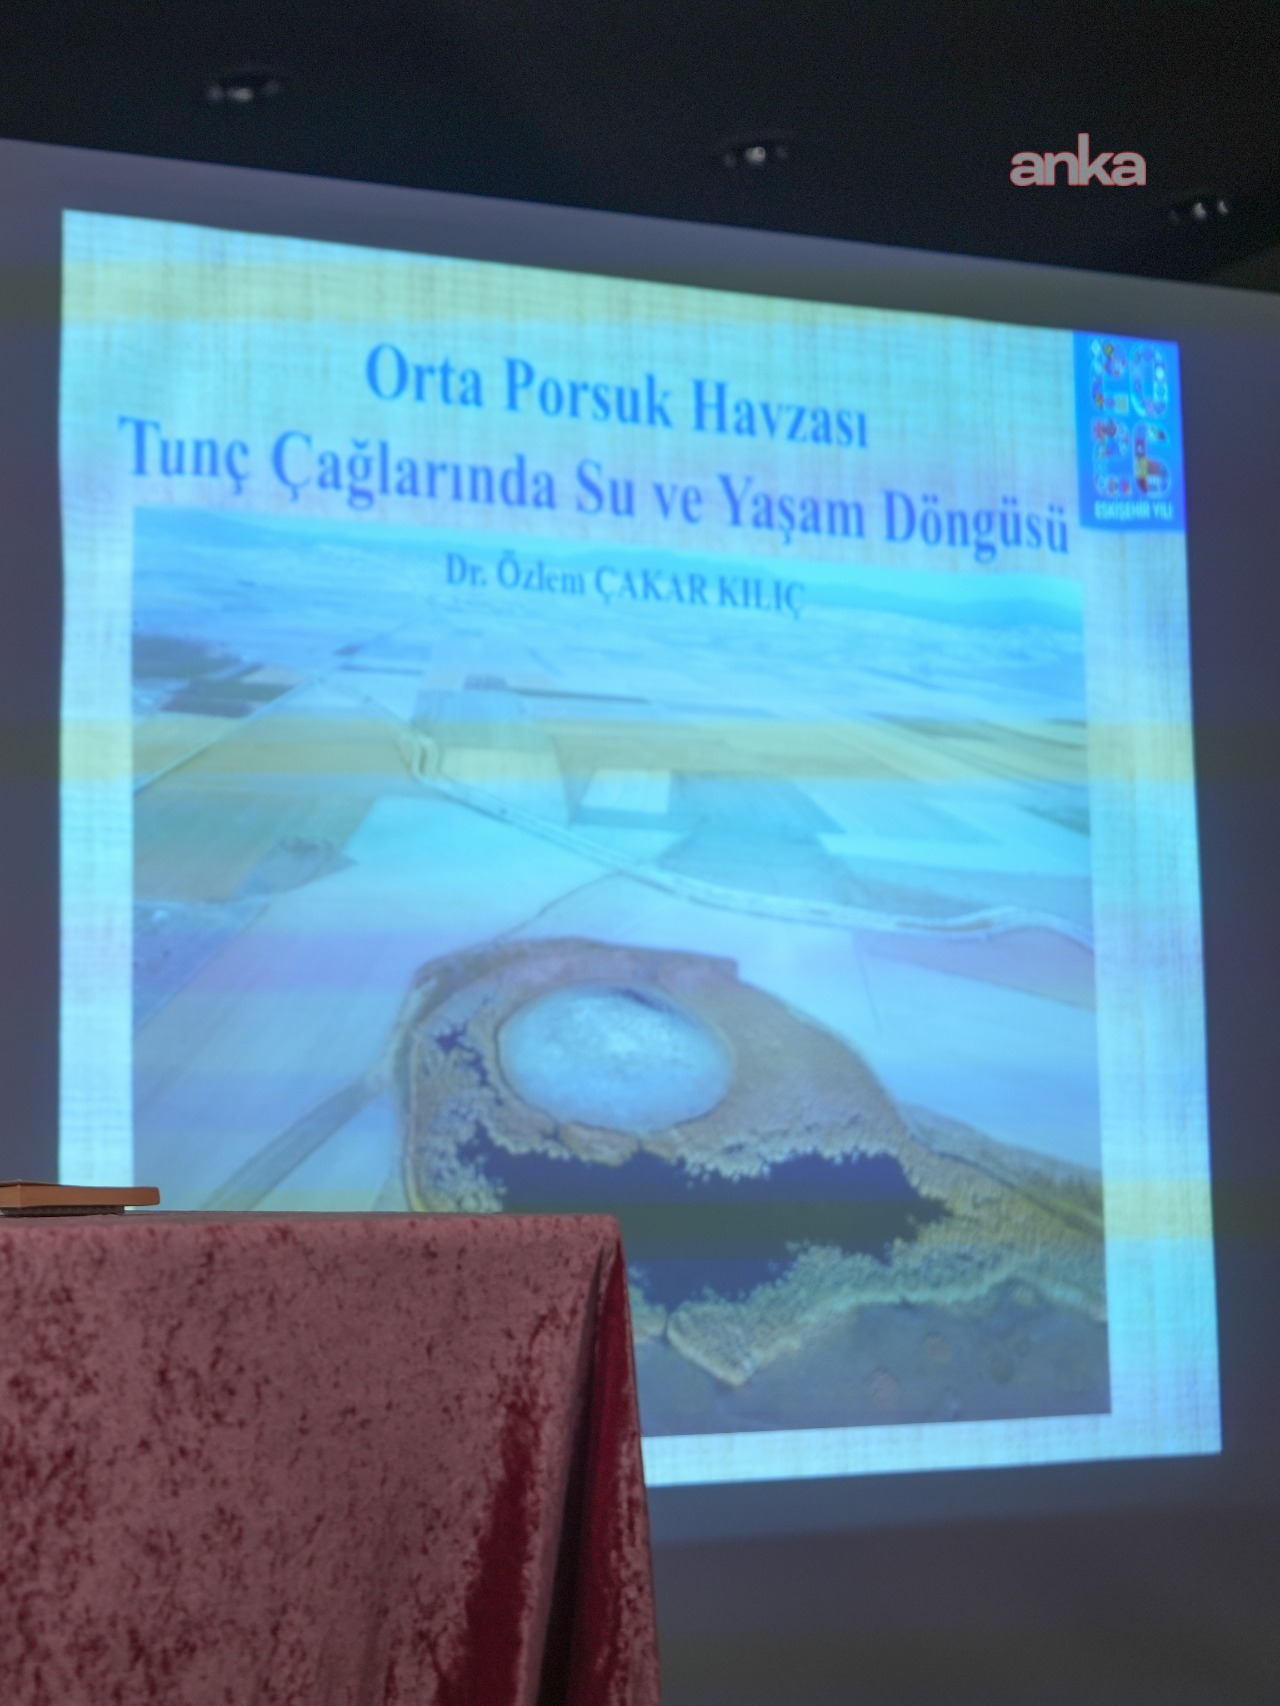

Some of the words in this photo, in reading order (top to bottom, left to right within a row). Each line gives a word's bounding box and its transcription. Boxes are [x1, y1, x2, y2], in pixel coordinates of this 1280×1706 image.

[365, 342, 484, 408] Orta
[503, 356, 675, 429] Porsuk
[691, 377, 869, 449] Havzası
[117, 414, 251, 496] Tunç
[270, 429, 557, 511] Çağlarında
[575, 458, 637, 518] Su
[652, 481, 704, 524] ve
[717, 472, 866, 545] Yaşam
[883, 488, 1070, 564] Döngüsü
[445, 552, 488, 587] Dr.
[497, 550, 586, 596] Özlem
[594, 565, 709, 606] ÇAKAR
[717, 573, 807, 620] KILIÇ
